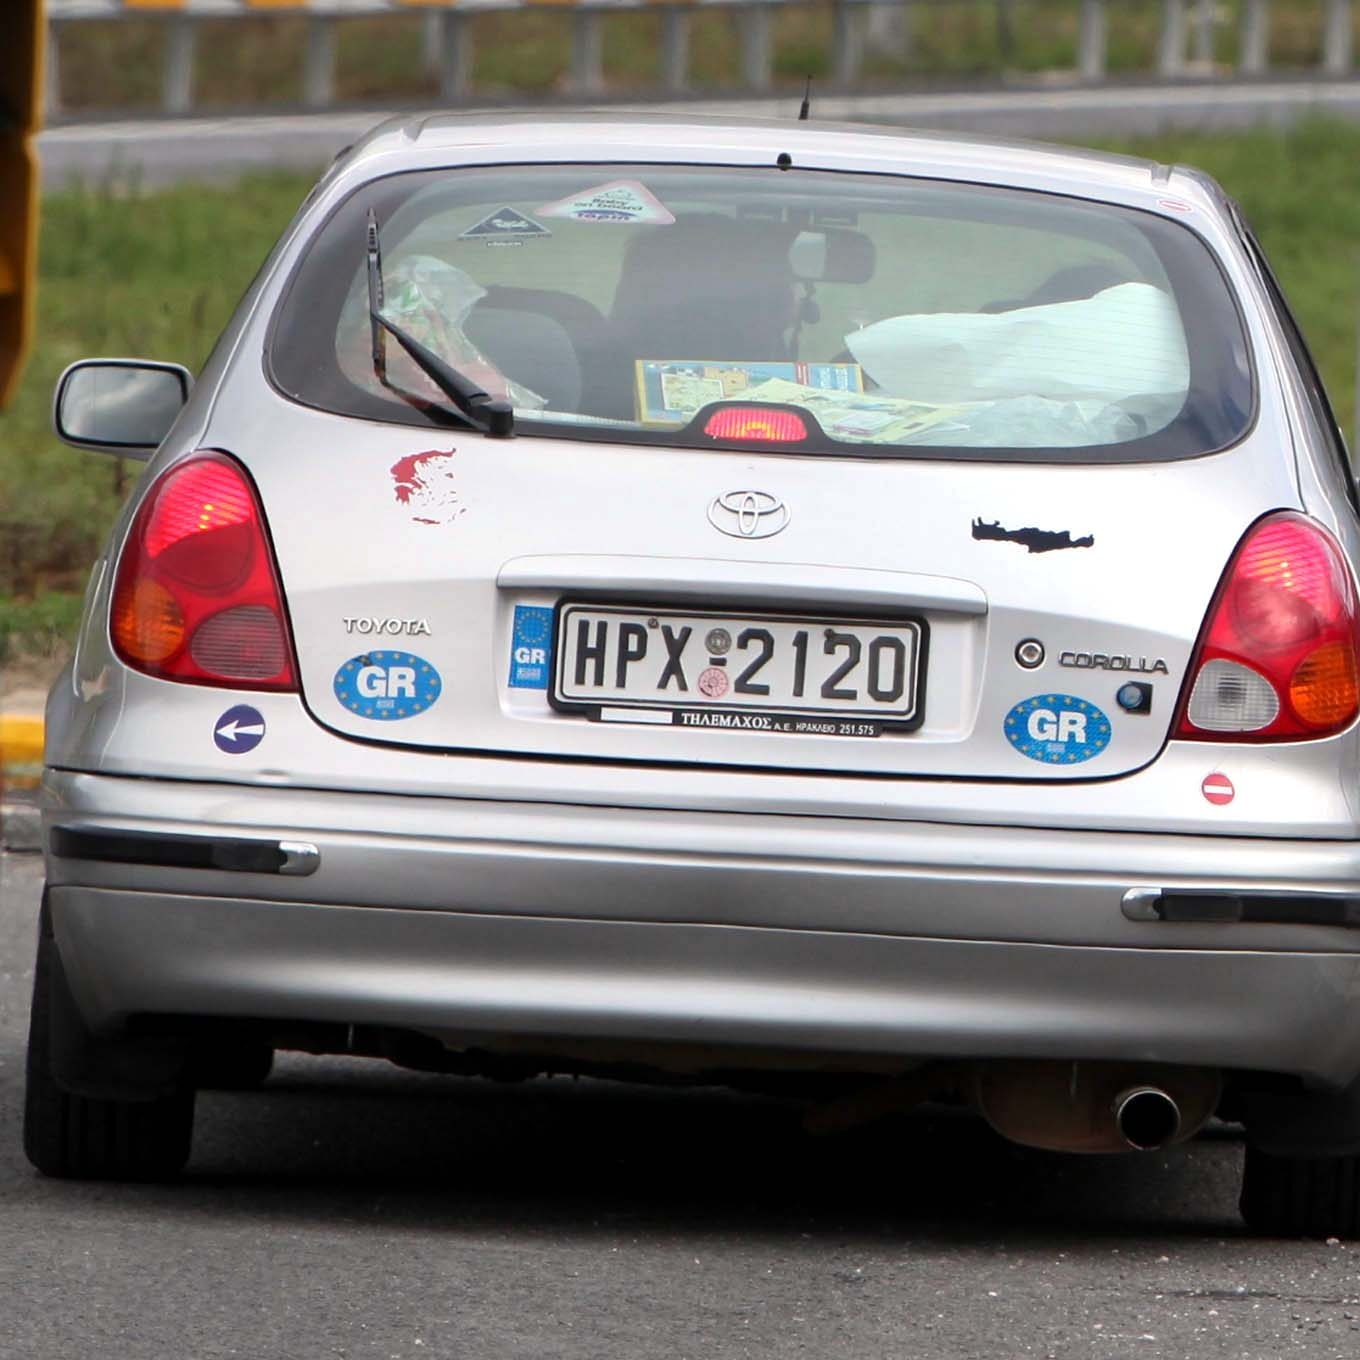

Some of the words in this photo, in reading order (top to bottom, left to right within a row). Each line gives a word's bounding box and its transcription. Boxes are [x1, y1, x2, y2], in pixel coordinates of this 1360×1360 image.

[343, 617, 431, 636] TOYOTA
[513, 647, 545, 664] GR
[1060, 650, 1168, 674] COROLLA
[356, 665, 416, 698] GR
[681, 712, 772, 729] ΤΗΛΕΜΑΧΟΣ
[840, 724, 874, 736] 251.575
[1027, 708, 1087, 743] GR
